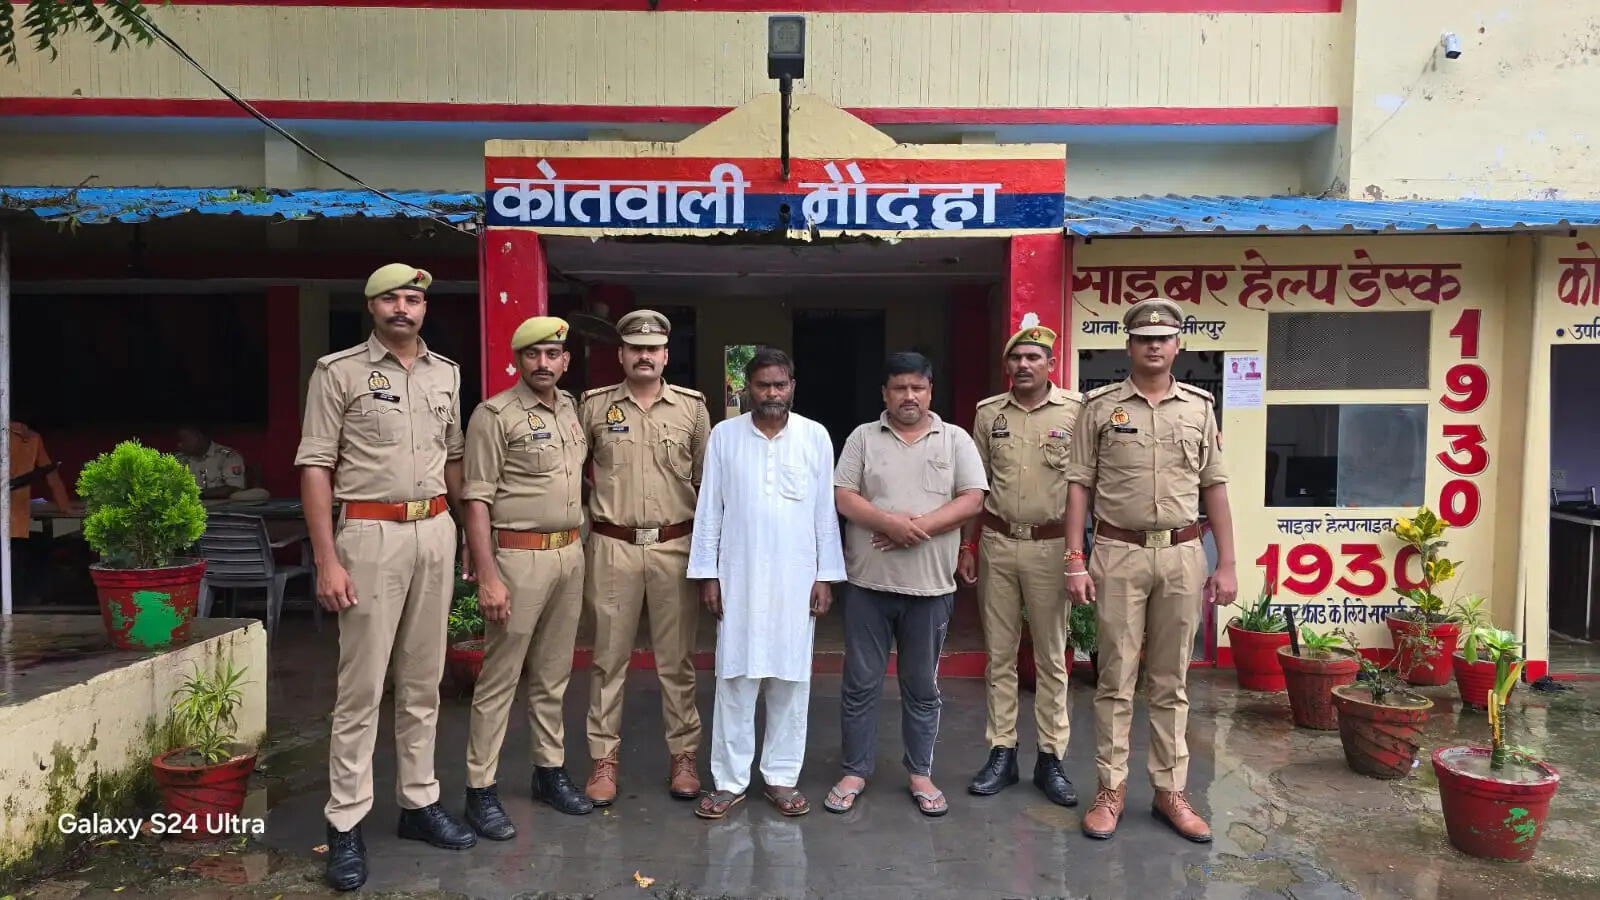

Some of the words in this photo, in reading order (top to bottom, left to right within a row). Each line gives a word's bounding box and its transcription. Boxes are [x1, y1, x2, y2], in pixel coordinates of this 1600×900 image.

[493, 159, 750, 225] कोतवाली
[798, 161, 1002, 229] मौदहा
[1071, 264, 1236, 316] साइबर
[1238, 248, 1342, 311] हेल्प
[1345, 248, 1463, 308] डेस्क
[1180, 315, 1226, 340] मीरपुर
[1435, 308, 1491, 528] 1930
[1277, 518, 1322, 537] साइबर
[1325, 513, 1392, 533] हेल्पलाइन
[1255, 542, 1429, 597] 1930
[1326, 597, 1341, 624] के
[1343, 596, 1367, 625] लिये
